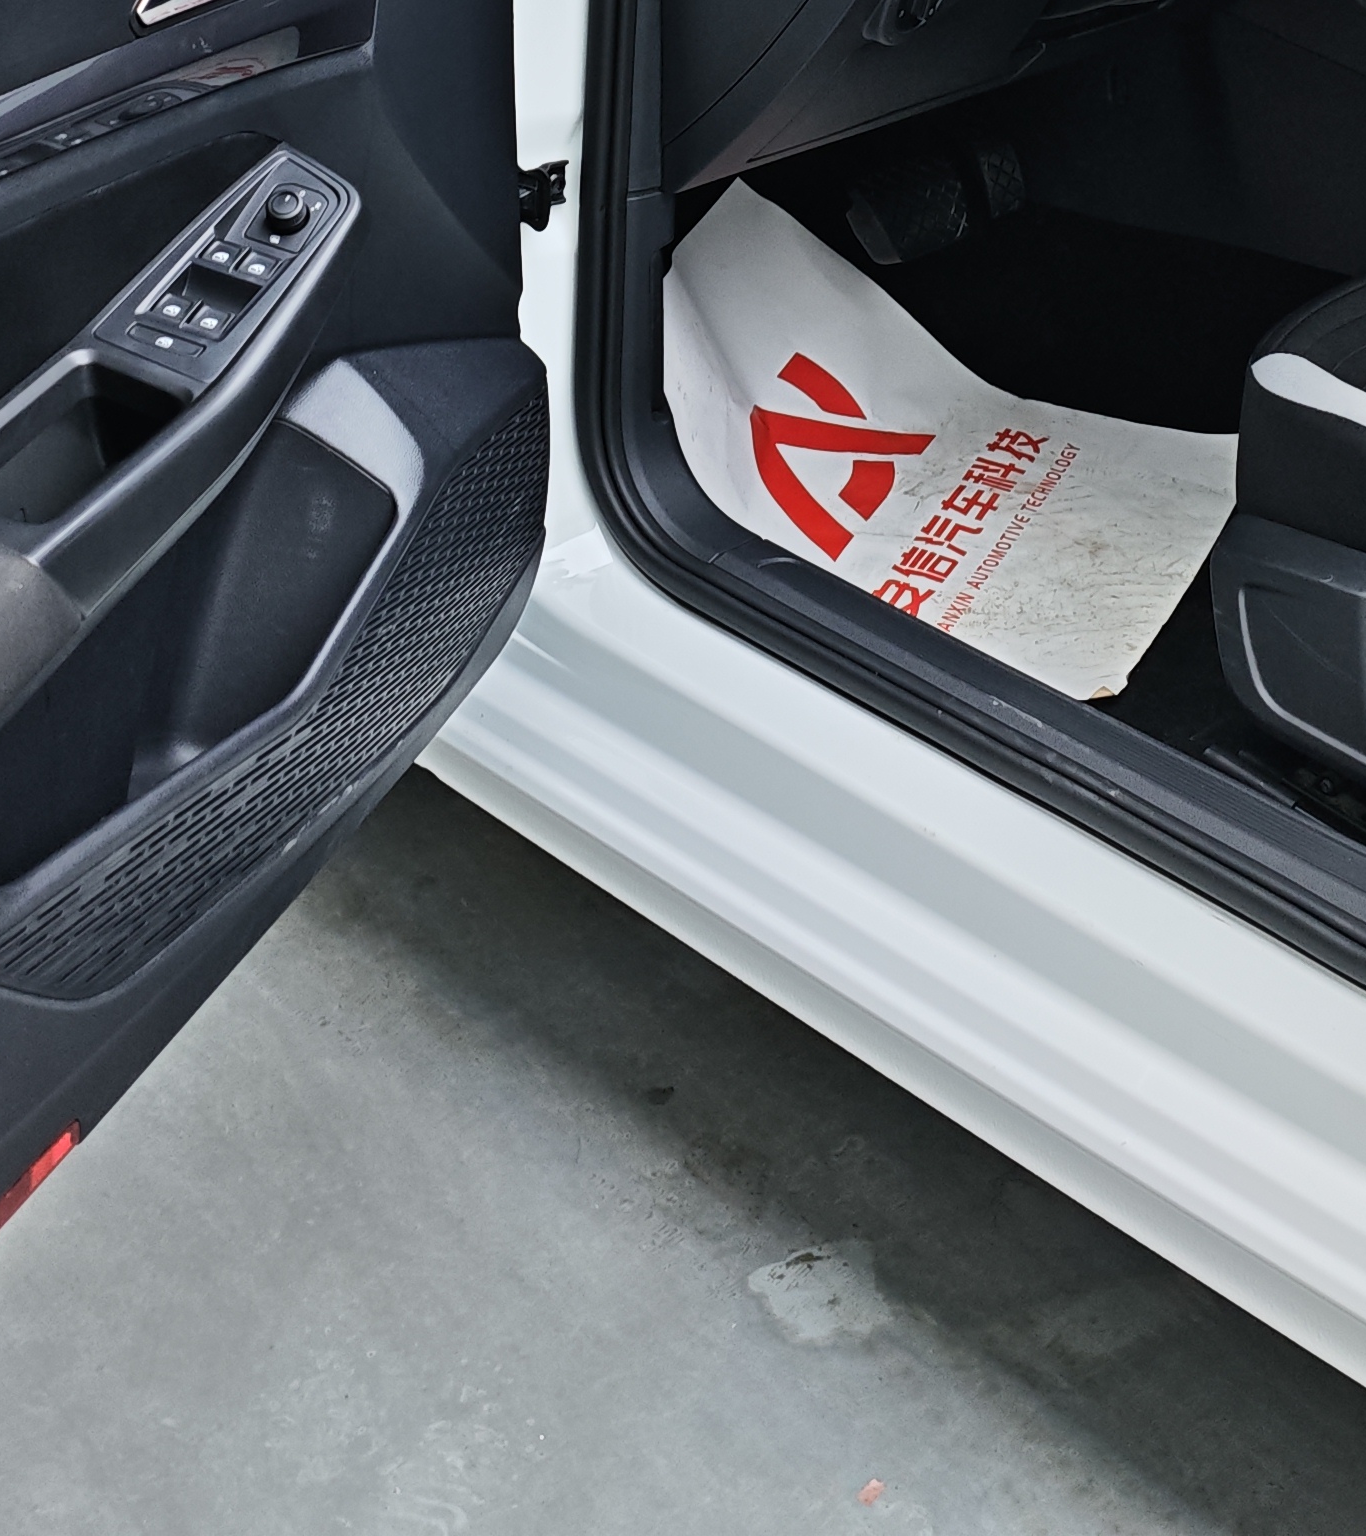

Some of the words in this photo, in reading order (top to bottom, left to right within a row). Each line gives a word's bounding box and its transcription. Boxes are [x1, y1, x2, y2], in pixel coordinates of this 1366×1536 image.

[936, 591, 975, 633] ANXIN
[966, 513, 1031, 591] AUTOMOTIVE
[1021, 442, 1081, 513] TECHNOLOGY
